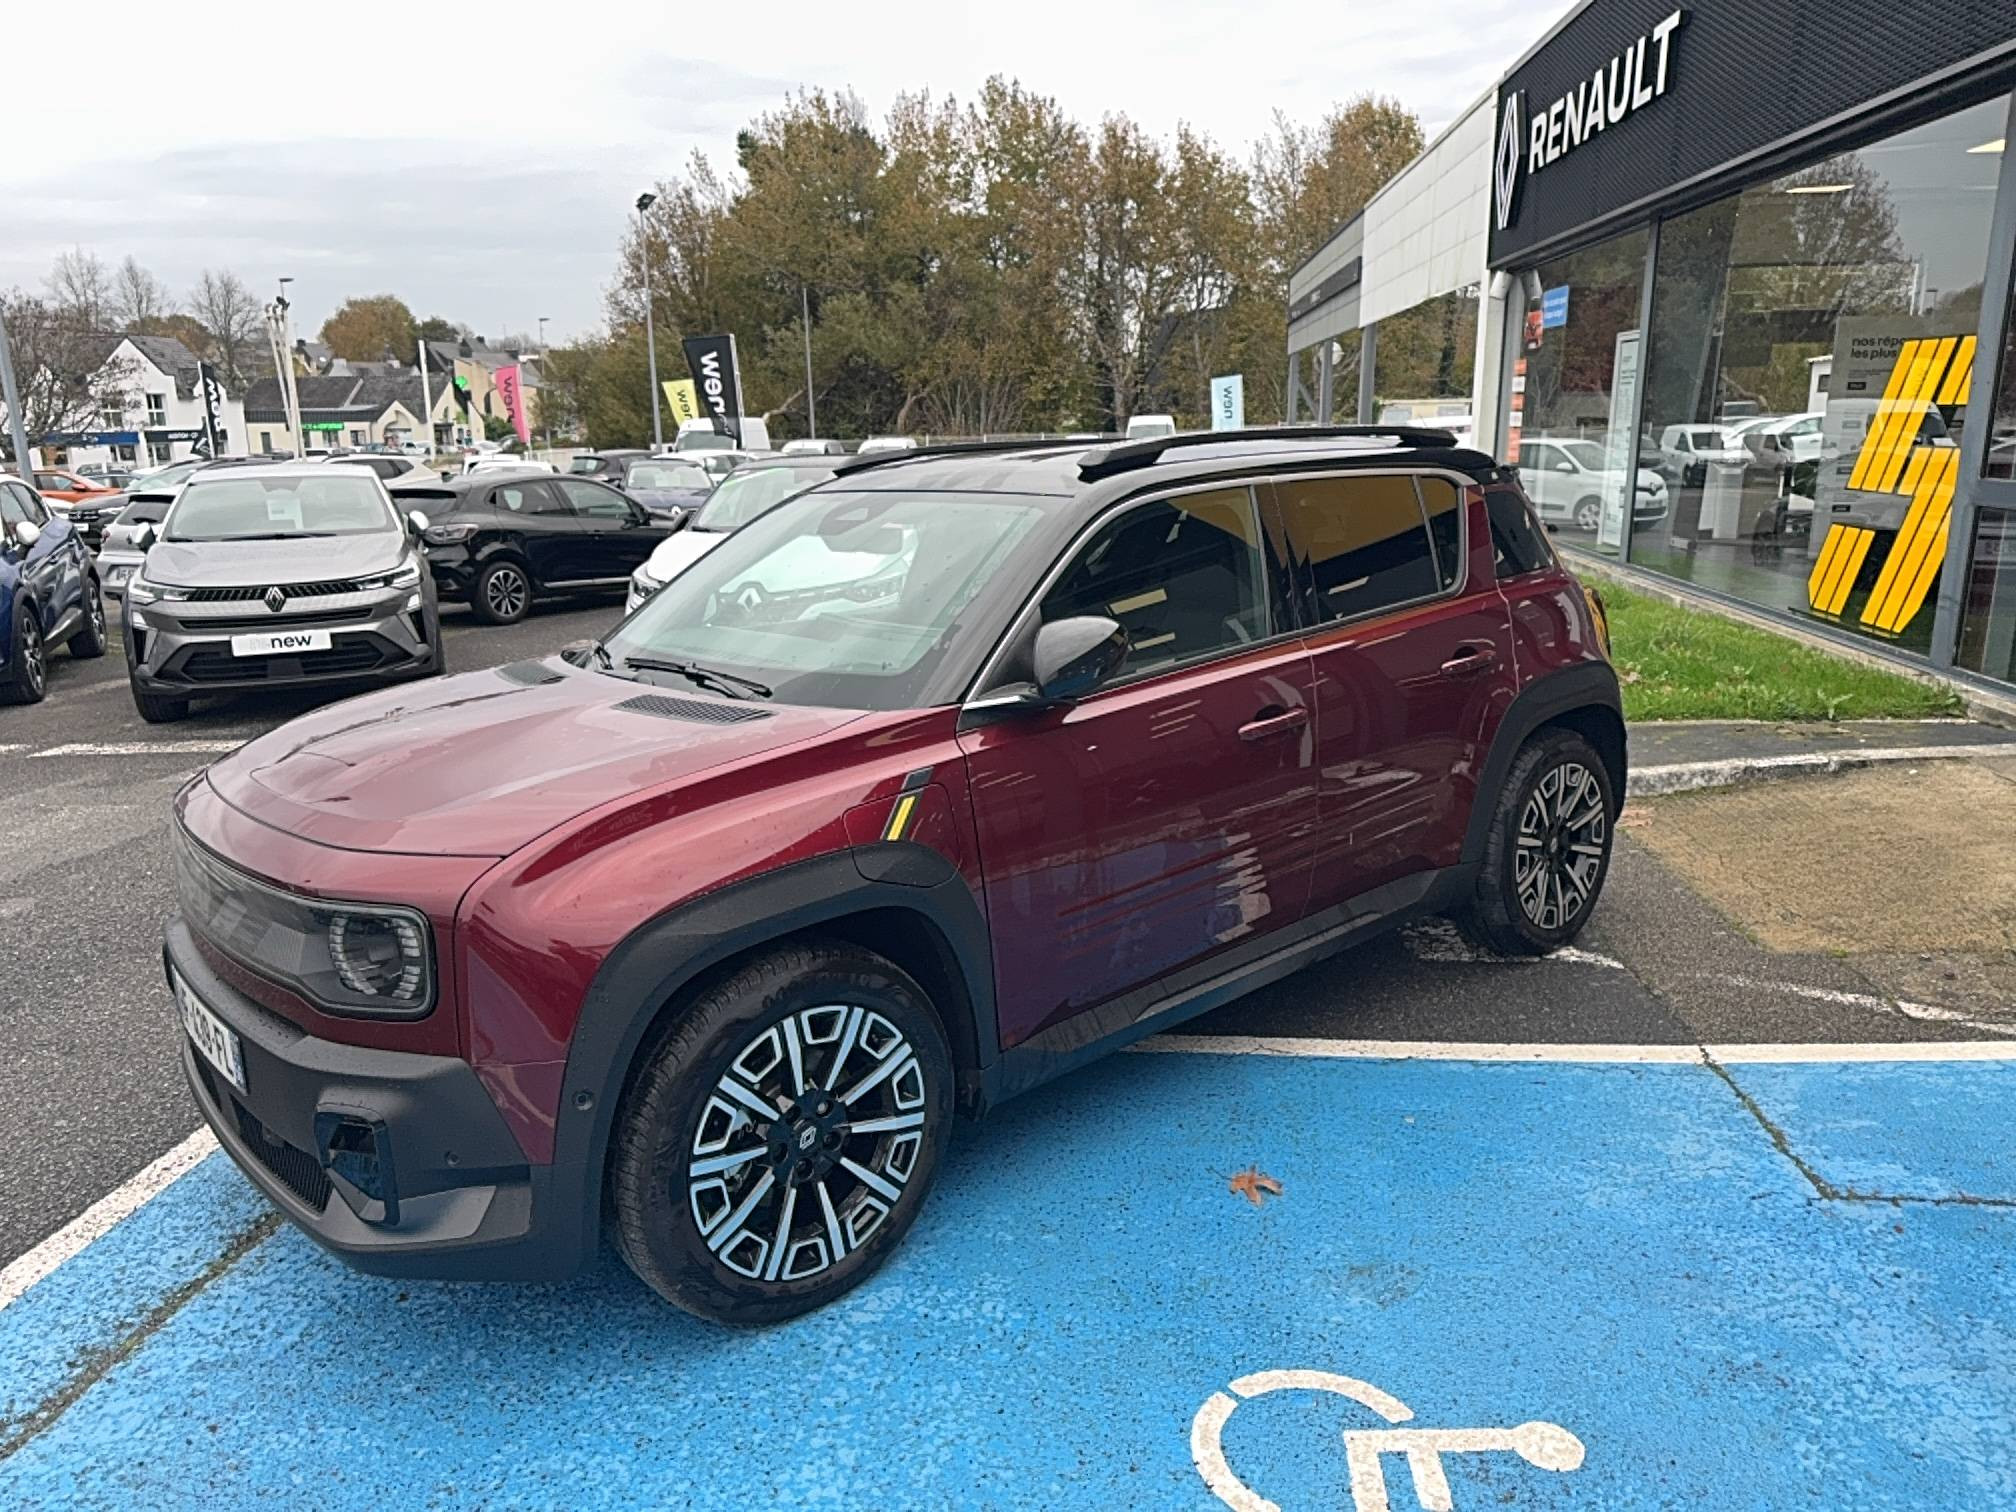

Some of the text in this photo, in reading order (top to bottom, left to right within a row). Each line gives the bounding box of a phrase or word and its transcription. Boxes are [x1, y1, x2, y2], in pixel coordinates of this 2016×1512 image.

[1529, 10, 1681, 174] RENAULT
[1851, 337, 1875, 347] nos
[1850, 347, 1897, 360] les plus
[270, 635, 312, 649] new
